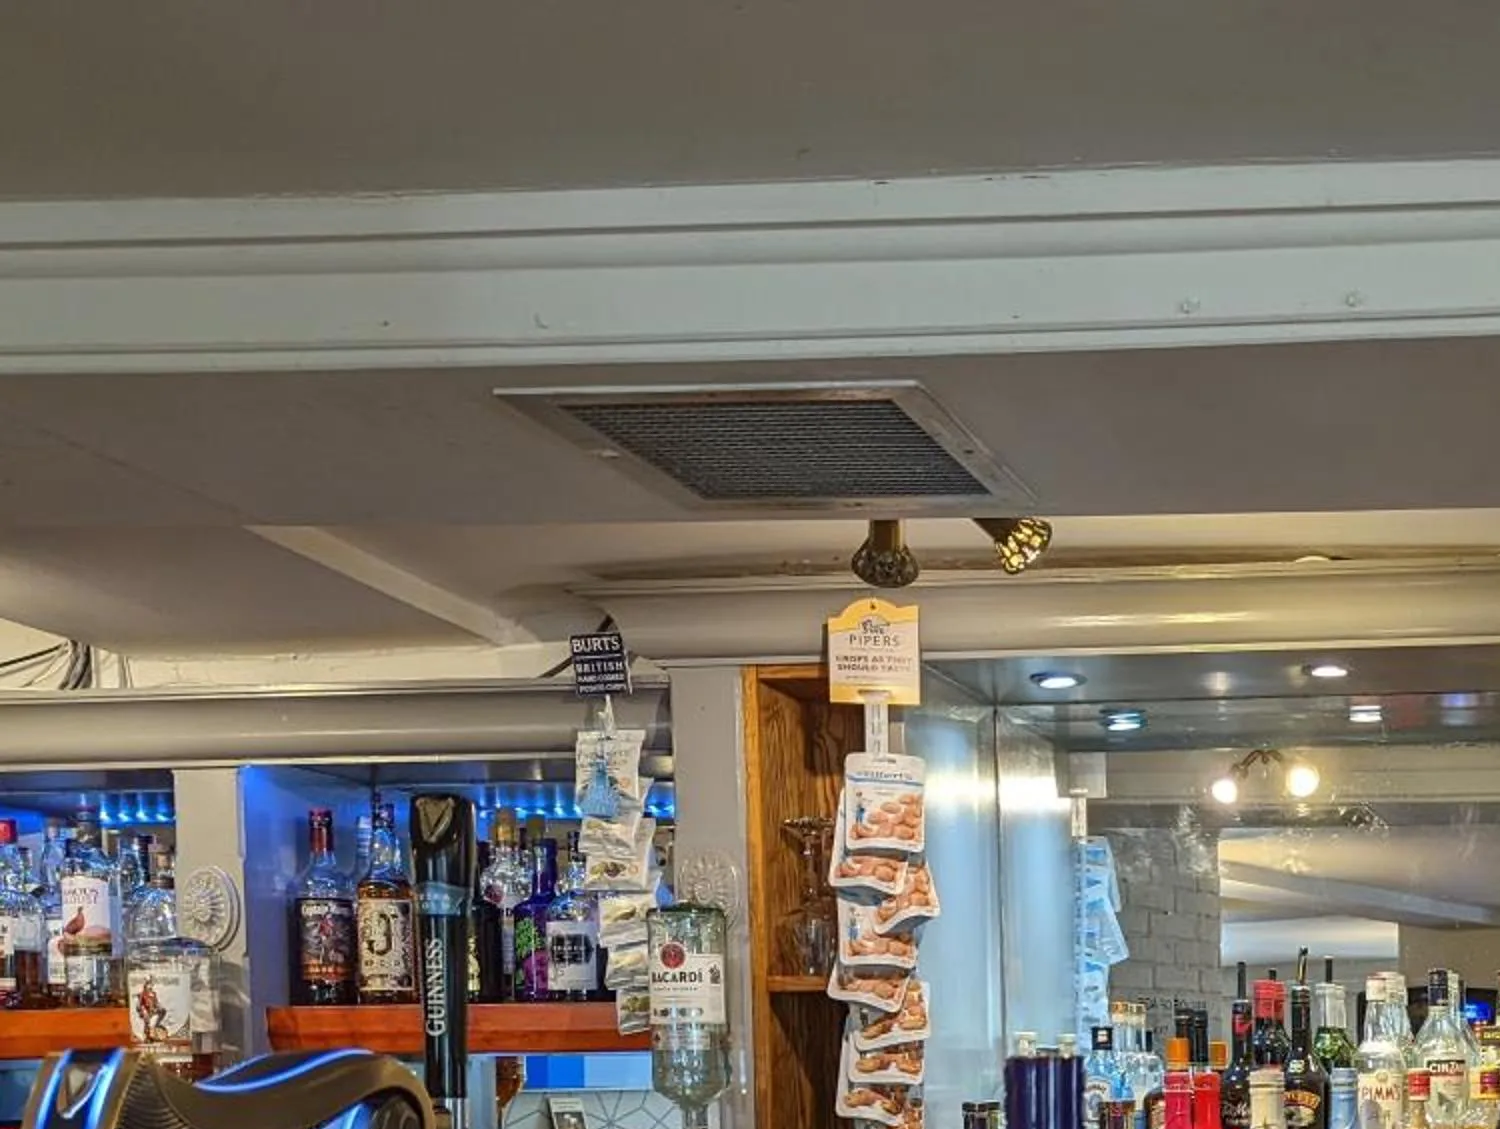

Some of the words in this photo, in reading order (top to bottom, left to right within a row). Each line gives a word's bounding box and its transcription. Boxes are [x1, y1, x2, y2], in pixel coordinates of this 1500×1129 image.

[571, 635, 620, 653] BURTS
[849, 634, 901, 647] PIPERS
[425, 938, 447, 1037] GUINNESS
